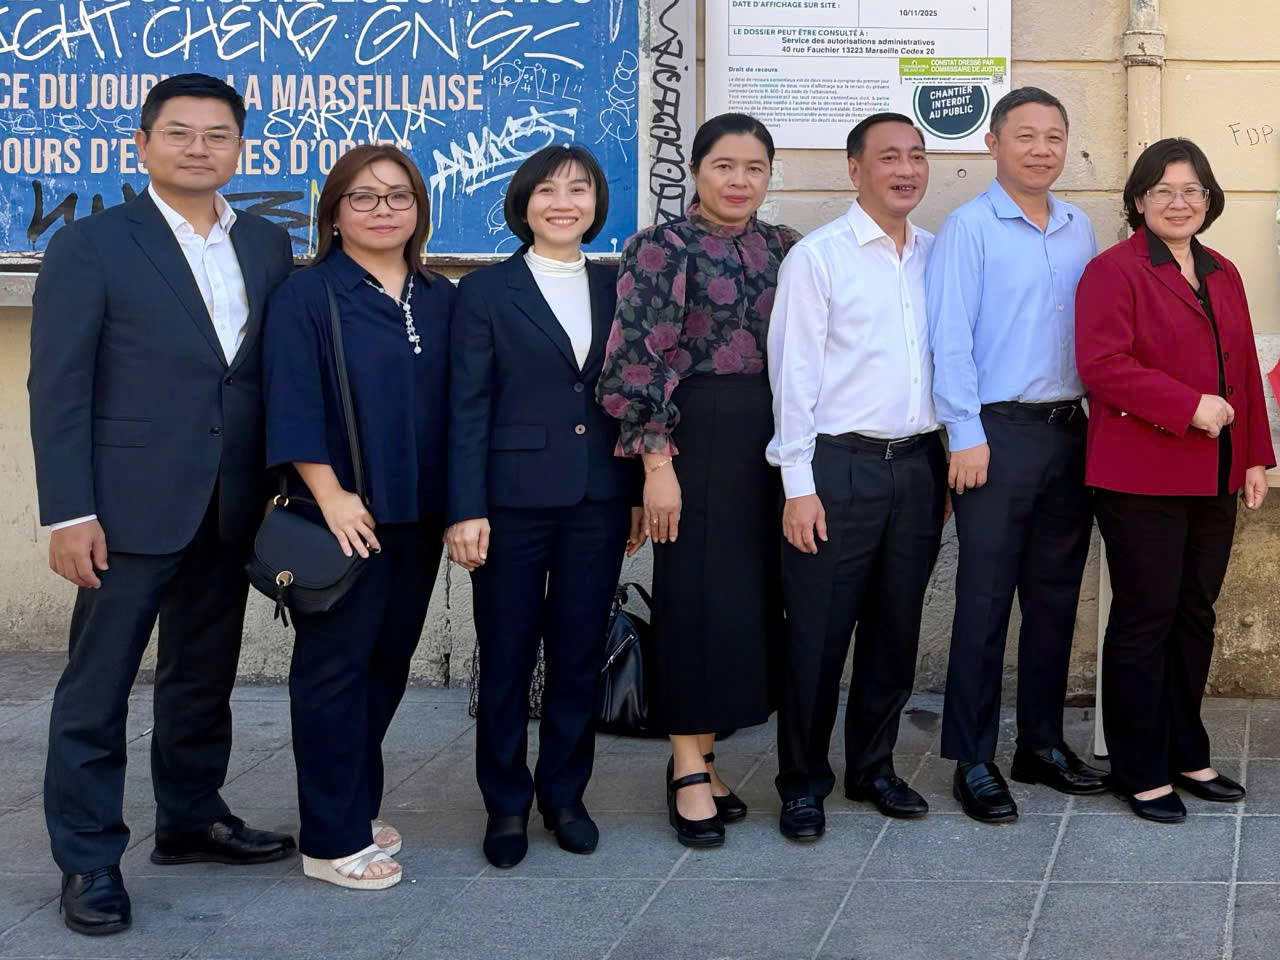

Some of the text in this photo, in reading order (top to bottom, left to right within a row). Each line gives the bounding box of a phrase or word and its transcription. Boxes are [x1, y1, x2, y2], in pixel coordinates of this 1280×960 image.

[899, 9, 938, 17] 10/11/2025
[743, 28, 776, 36] DOSSIER
[798, 28, 817, 36] ÊTRE
[818, 28, 858, 37] CONSULTÉ
[782, 36, 811, 44] Service
[827, 37, 877, 45] autorisations
[878, 38, 935, 46] administratives
[807, 46, 840, 54] Fauchier
[866, 47, 898, 55] Marseille
[901, 47, 924, 55] Cedex
[39, 74, 483, 111] DU MARSEILLAISE
[930, 86, 973, 100] CHANTIER
[932, 96, 971, 109] INTERDIT
[929, 105, 973, 120] AU PUBLIC
[1228, 122, 1274, 147] FDP
